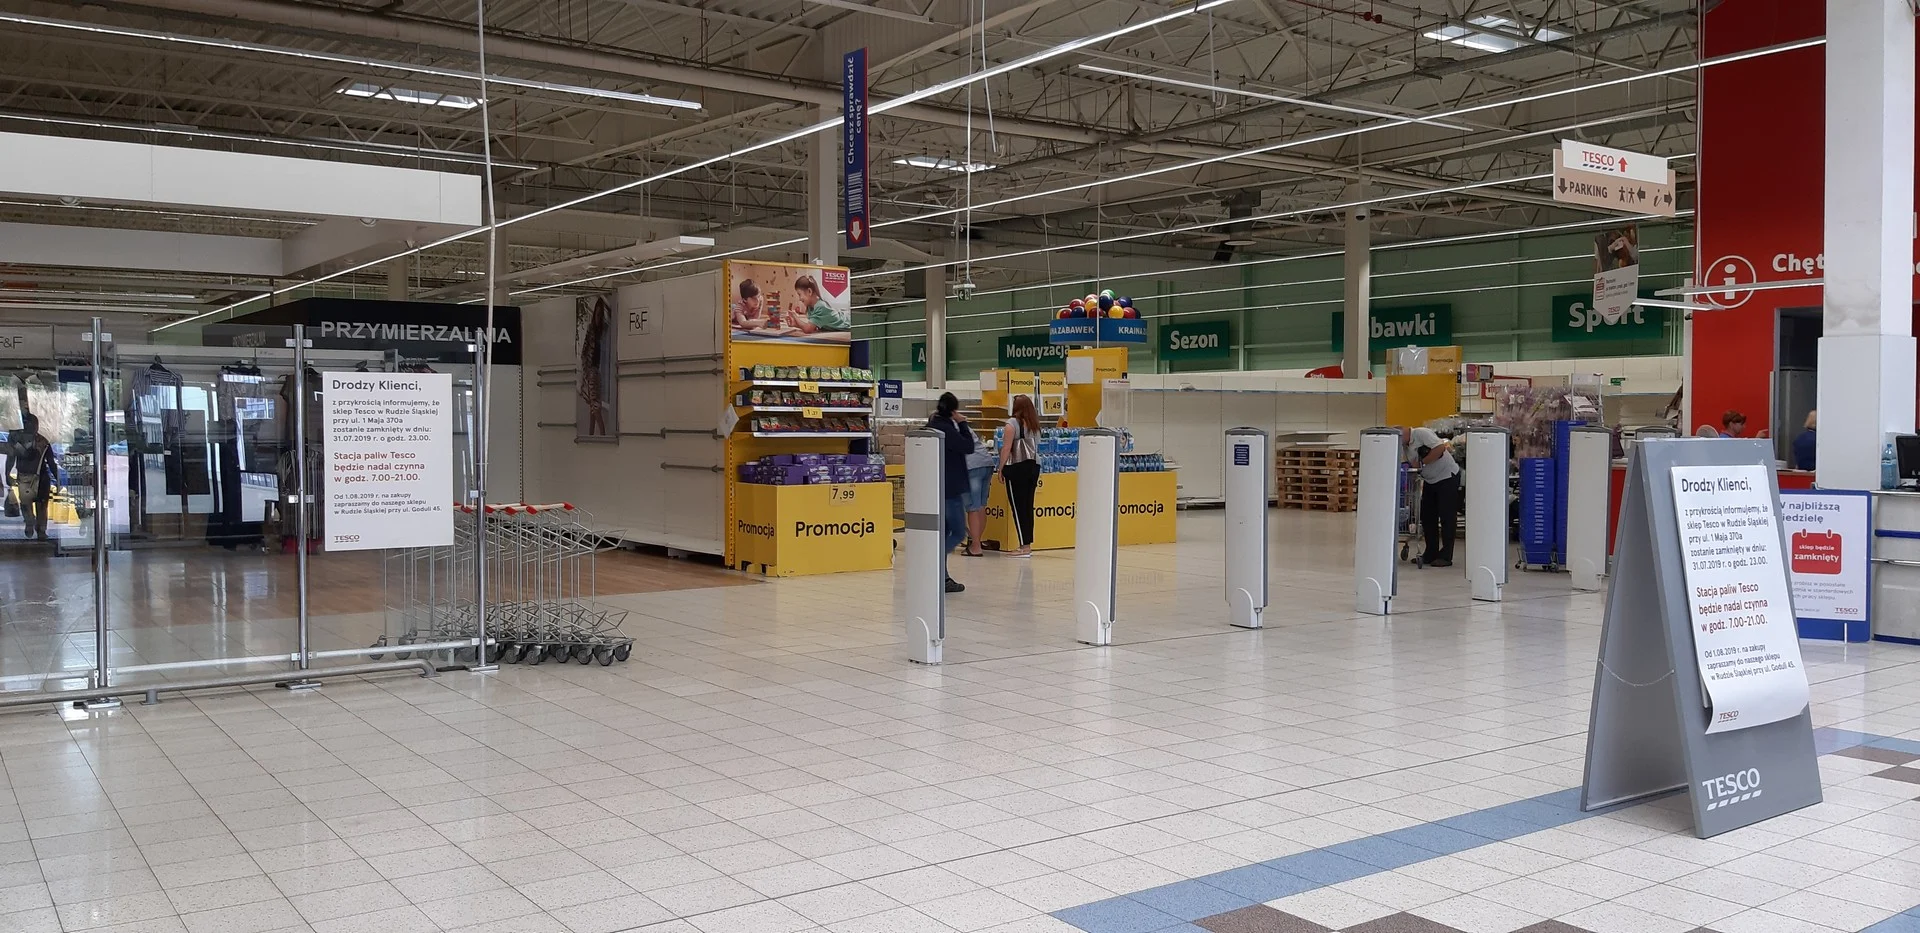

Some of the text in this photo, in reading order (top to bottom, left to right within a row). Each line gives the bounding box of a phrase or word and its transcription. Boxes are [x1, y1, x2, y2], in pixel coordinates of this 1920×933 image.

[1582, 150, 1614, 166] TESCO
[1569, 181, 1608, 198] PARKING
[630, 312, 647, 332] F&F
[1371, 312, 1435, 338] bawki
[1058, 326, 1094, 334] ZABAWEK
[1170, 330, 1218, 350] Sezon
[1006, 344, 1070, 360] Motoryzacja
[333, 380, 422, 392] Drodzy Klienci,
[338, 400, 381, 408] przykrością
[333, 408, 352, 416] sklep
[411, 407, 438, 416] Śląskiej
[368, 417, 384, 425] Maja
[334, 452, 361, 460] Stacja
[364, 452, 387, 460] paliw
[334, 464, 364, 472] będzie
[345, 475, 368, 484] godz.
[1681, 477, 1752, 495] Drodzy Klienci,
[832, 488, 854, 500] 7.99
[985, 505, 1004, 518] ocja
[1689, 505, 1722, 518] przykrością
[1723, 505, 1761, 515] informujemy,
[1762, 504, 1768, 513] że
[1789, 502, 1840, 512] najbliższą
[1687, 520, 1702, 530] sklep
[1703, 520, 1719, 528] Tesco
[1727, 518, 1746, 527] Rudzie
[1748, 517, 1769, 527] Śląskiej
[1782, 514, 1824, 524] iedzielę
[738, 519, 774, 539] Promocja
[795, 518, 875, 538] Promocja
[1689, 535, 1701, 545] przy
[1715, 533, 1728, 542] Maja
[1729, 532, 1742, 540] 370a
[1691, 547, 1715, 557] zostanie
[1716, 546, 1744, 556] zamknięty
[1752, 544, 1767, 552] dniu:
[1692, 560, 1721, 570] 31.07.2019
[1733, 558, 1748, 569] godz.
[1750, 556, 1768, 566] 23.00.
[1794, 553, 1839, 563] zamknięty
[1696, 583, 1759, 599] Stacja paliw Tesco
[1698, 599, 1768, 616] będzie nadal czynna
[1701, 623, 1707, 632] w
[1709, 620, 1728, 634] godz.
[1713, 647, 1736, 657] 1.08.2019
[1749, 644, 1765, 653] zakupy
[1707, 660, 1737, 670] zapraszamy
[1744, 656, 1763, 664] naszego
[1765, 653, 1780, 661] sklepu
[1716, 671, 1734, 680] Rudzie
[1735, 668, 1753, 678] Śląskiej
[1753, 666, 1764, 675] przy
[1771, 662, 1787, 671] Goduli
[1788, 660, 1796, 668] 45.
[1719, 711, 1739, 720] TESCO
[1702, 768, 1760, 800] TESCO
